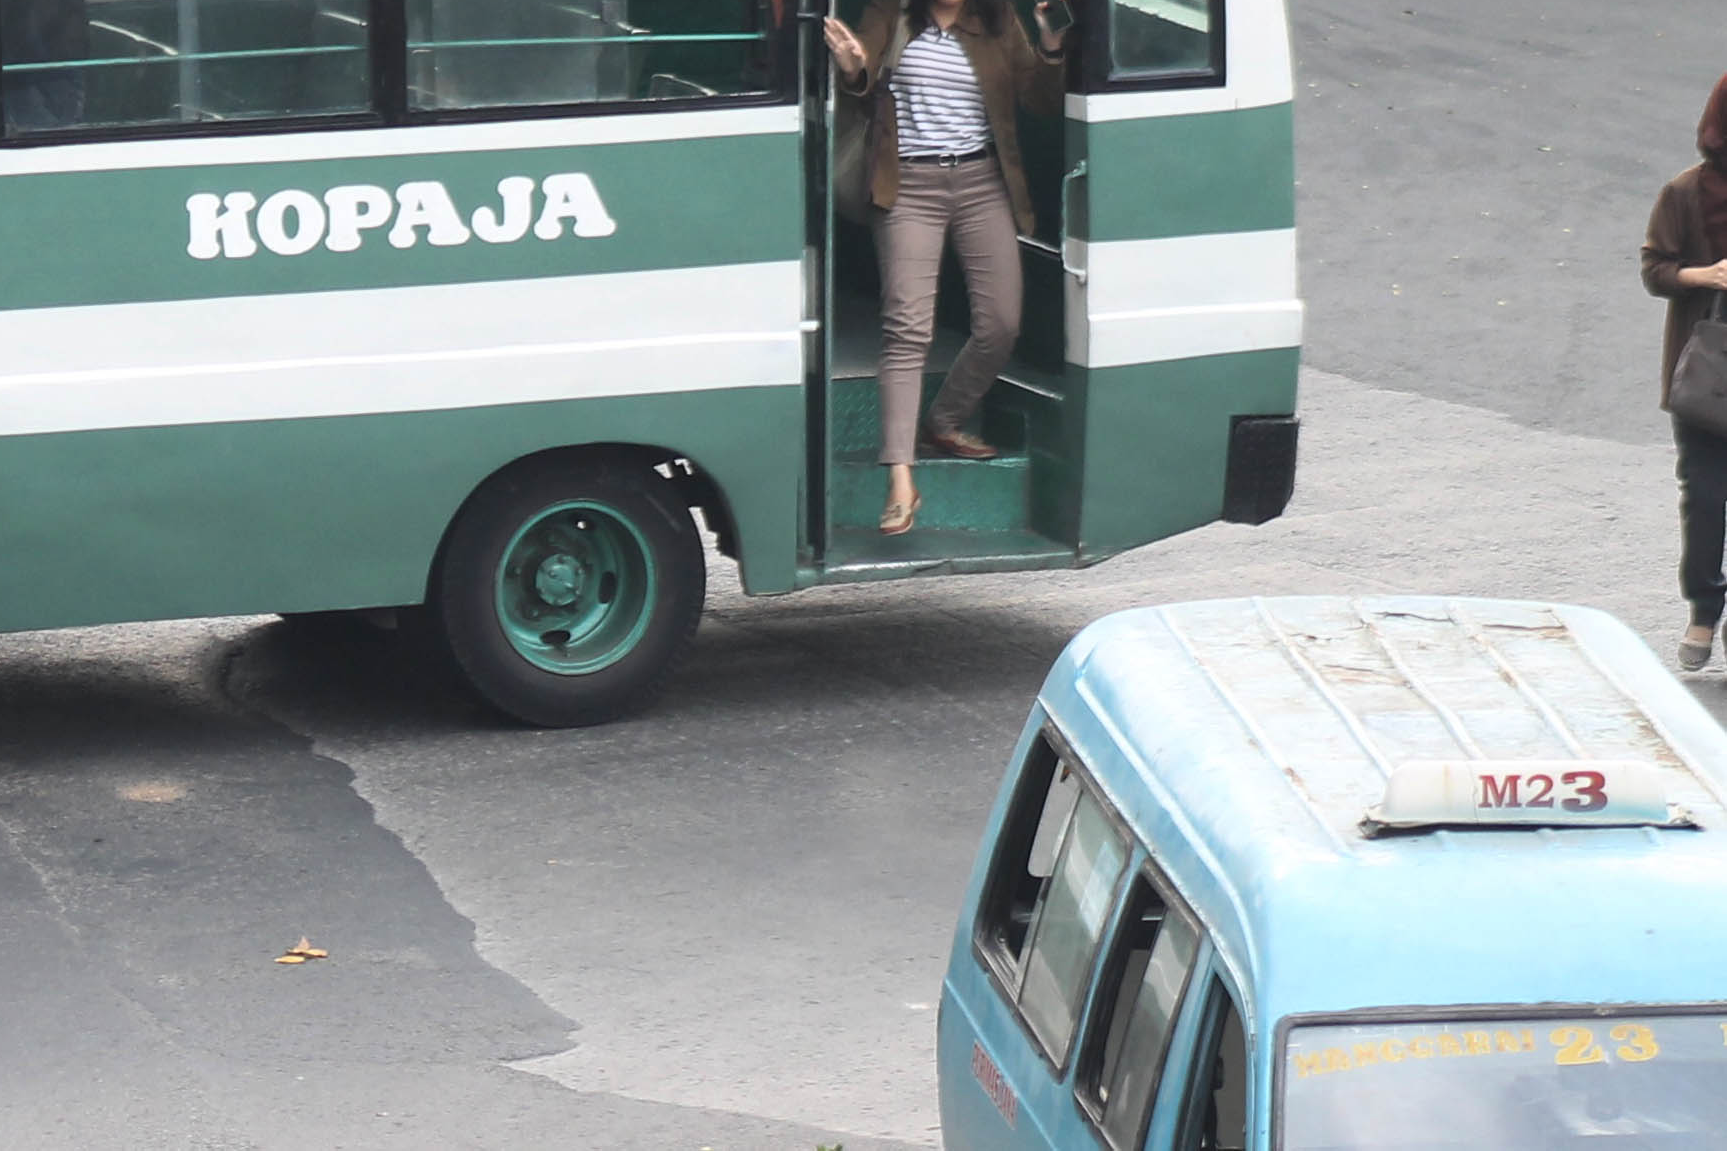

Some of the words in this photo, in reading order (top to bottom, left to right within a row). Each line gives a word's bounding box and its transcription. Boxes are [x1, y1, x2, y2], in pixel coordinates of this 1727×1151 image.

[186, 172, 616, 260] KOPAJA
[1477, 770, 1609, 813] M23
[1548, 1023, 1660, 1066] 23
